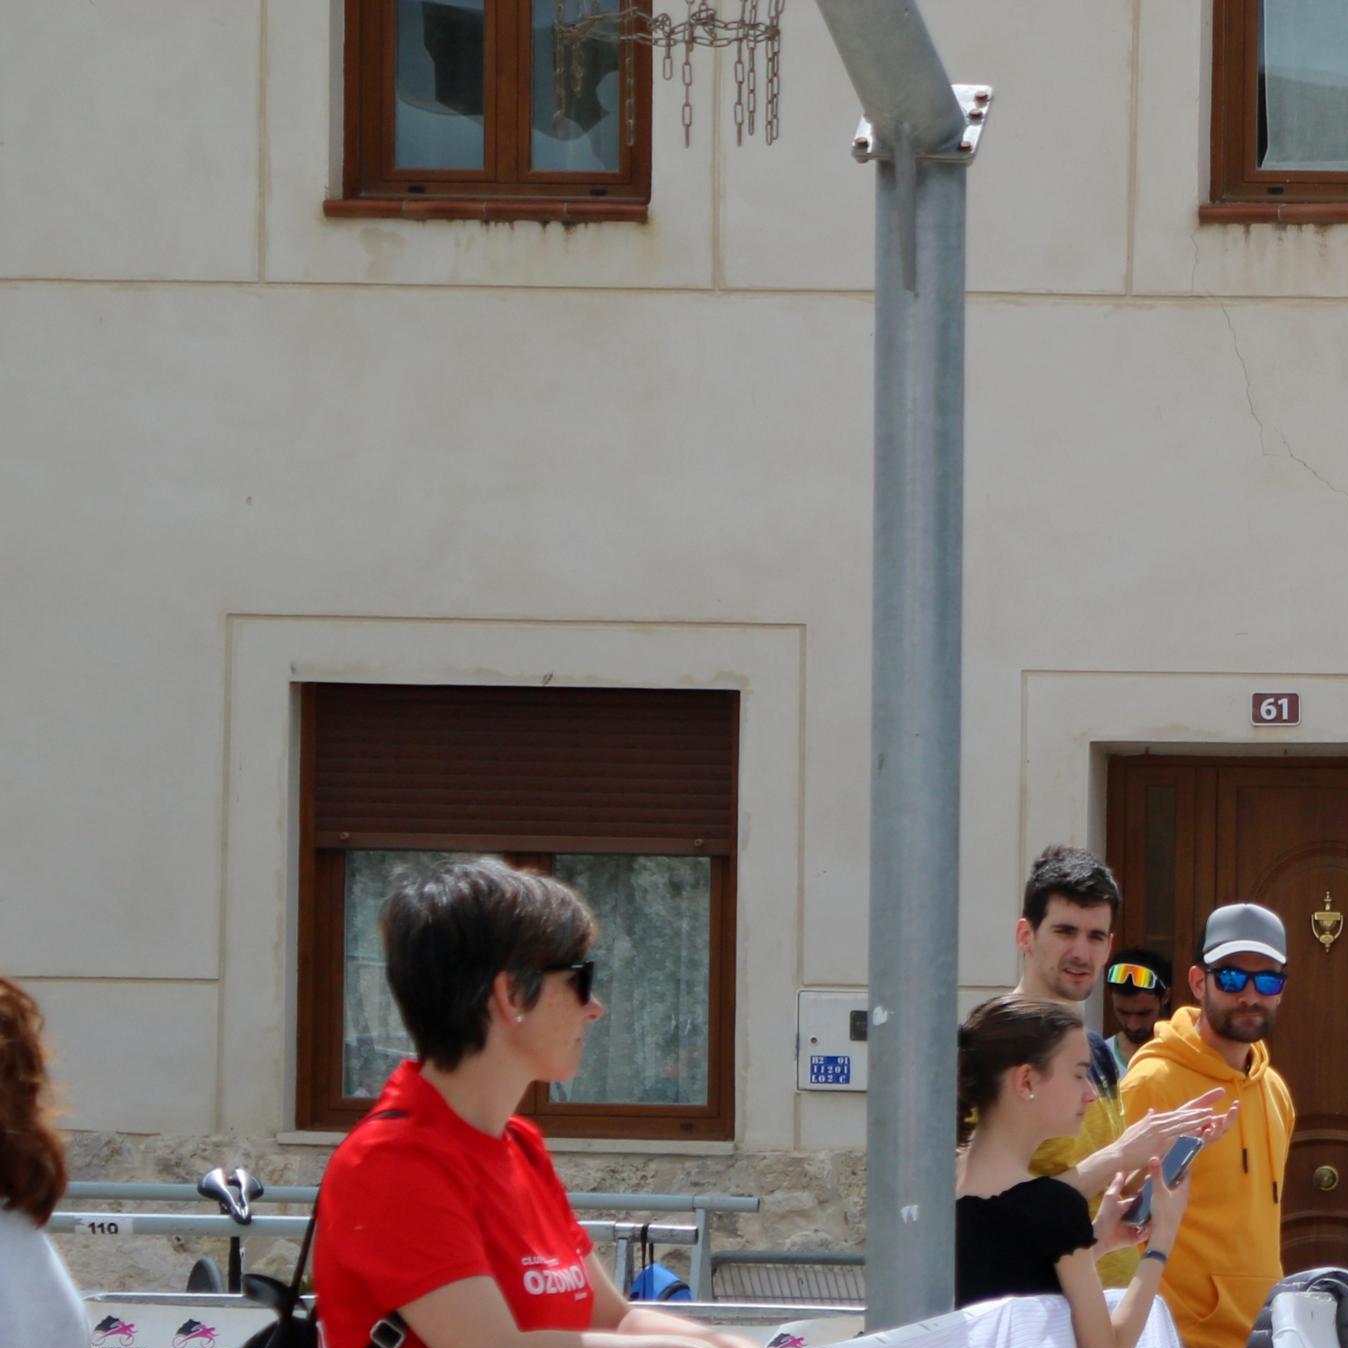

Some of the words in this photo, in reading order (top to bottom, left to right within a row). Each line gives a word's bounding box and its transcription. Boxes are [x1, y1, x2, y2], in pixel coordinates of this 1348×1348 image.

[1260, 698, 1289, 720] 61
[88, 1222, 119, 1235] 110
[523, 1265, 585, 1296] OZONO
